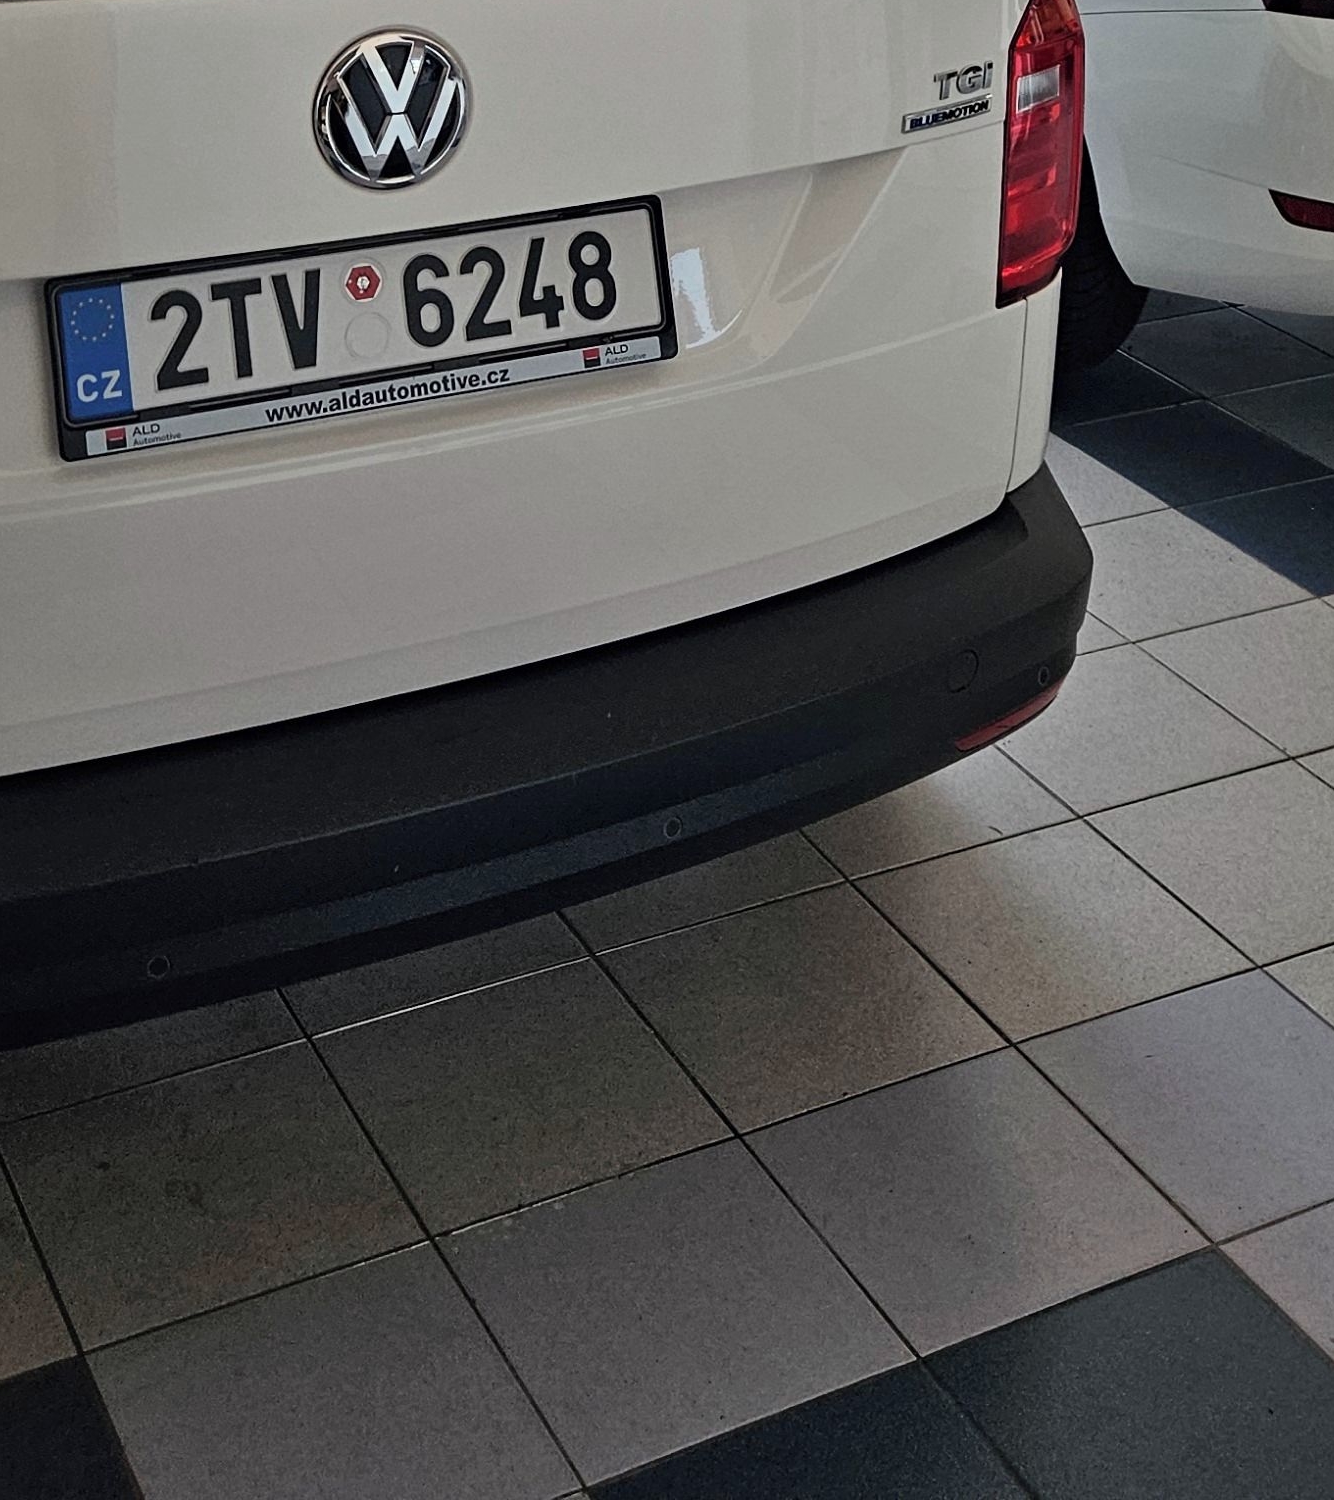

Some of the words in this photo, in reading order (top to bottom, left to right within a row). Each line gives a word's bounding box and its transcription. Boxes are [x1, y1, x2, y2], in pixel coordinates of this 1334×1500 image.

[933, 60, 993, 101] TGI
[909, 99, 990, 130] BLUEMOTION
[150, 267, 322, 392] 2TV
[401, 230, 617, 348] 6248
[605, 344, 629, 356] ALD
[605, 353, 647, 365] Automotive
[77, 369, 123, 402] CZ
[265, 368, 511, 423] www.aldautomotive.cz
[132, 423, 161, 437] ALD
[132, 431, 181, 446] Automotive
